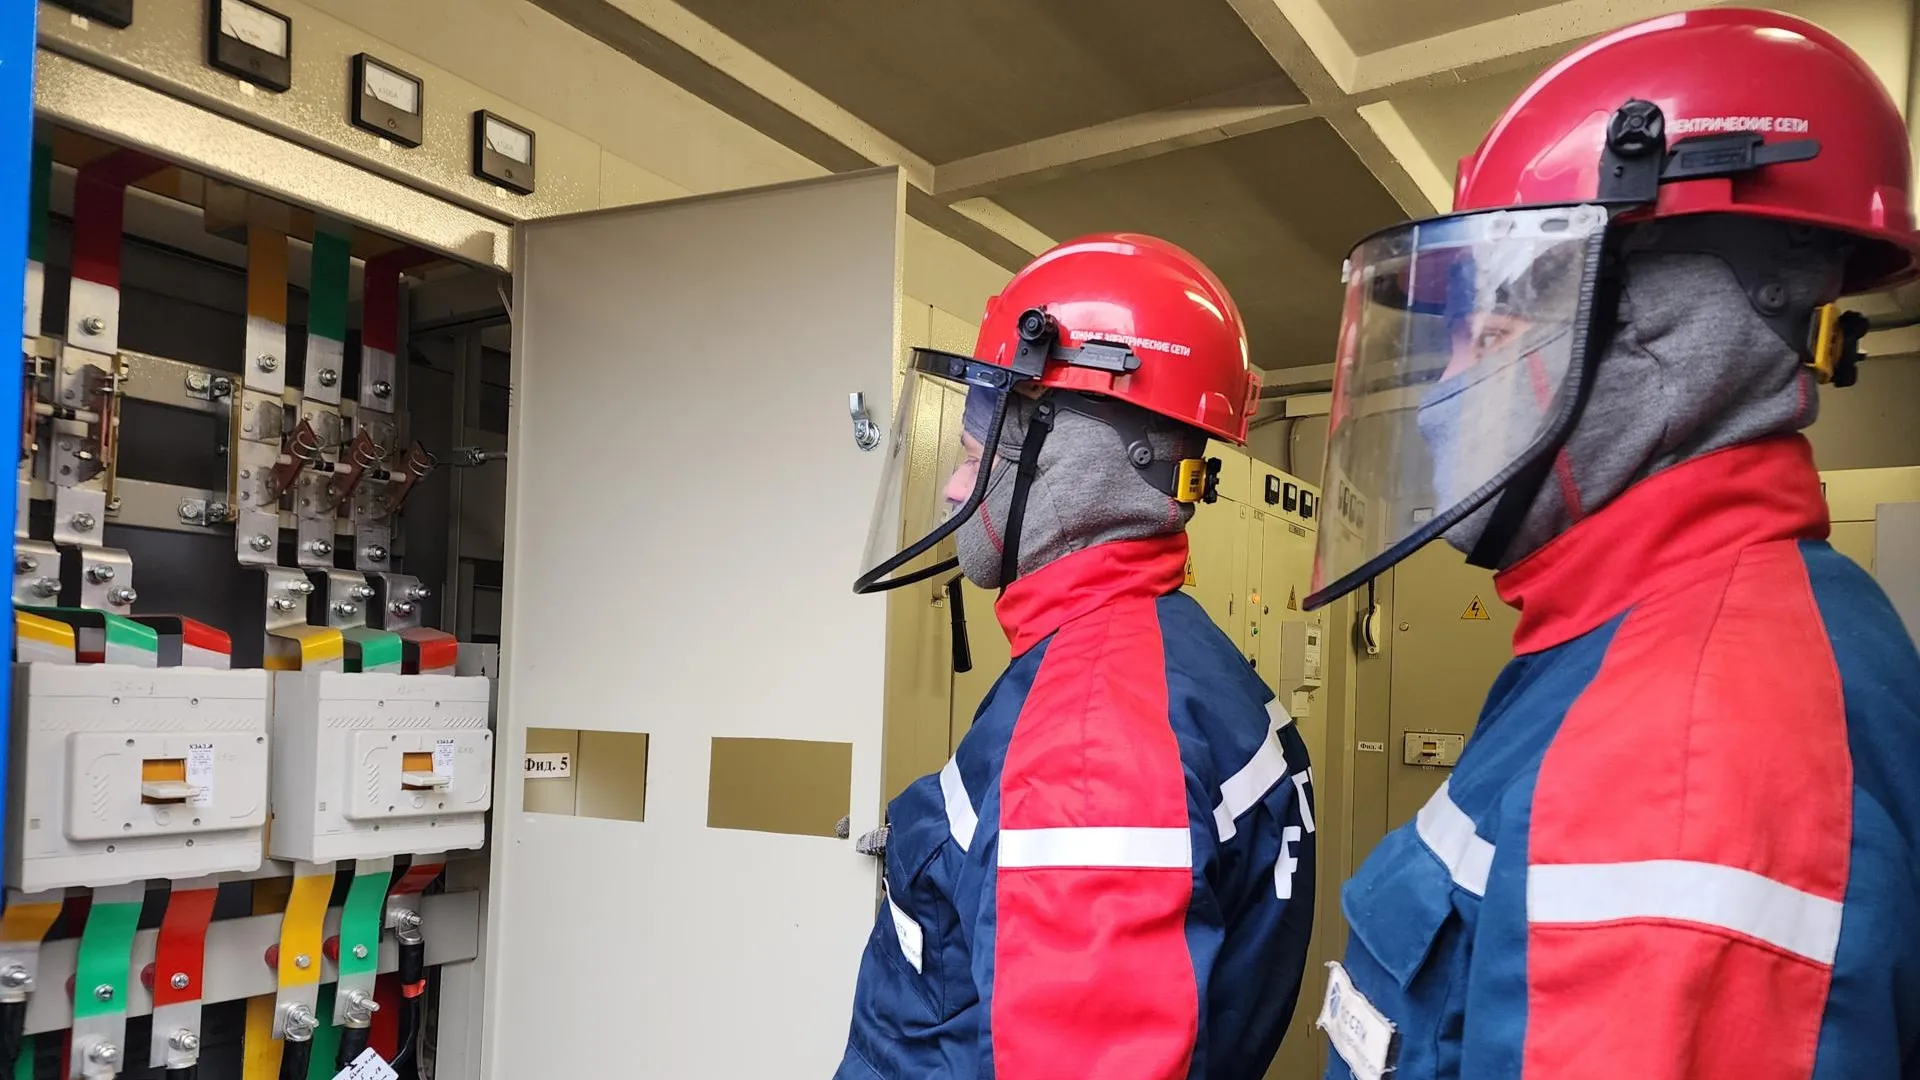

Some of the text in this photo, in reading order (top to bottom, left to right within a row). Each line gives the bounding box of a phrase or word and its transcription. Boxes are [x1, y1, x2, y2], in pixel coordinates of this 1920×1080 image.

[1773, 117, 1808, 133] СЕТИ
[1170, 343, 1191, 356] СЕТИ
[524, 757, 568, 772] Фид. 5
